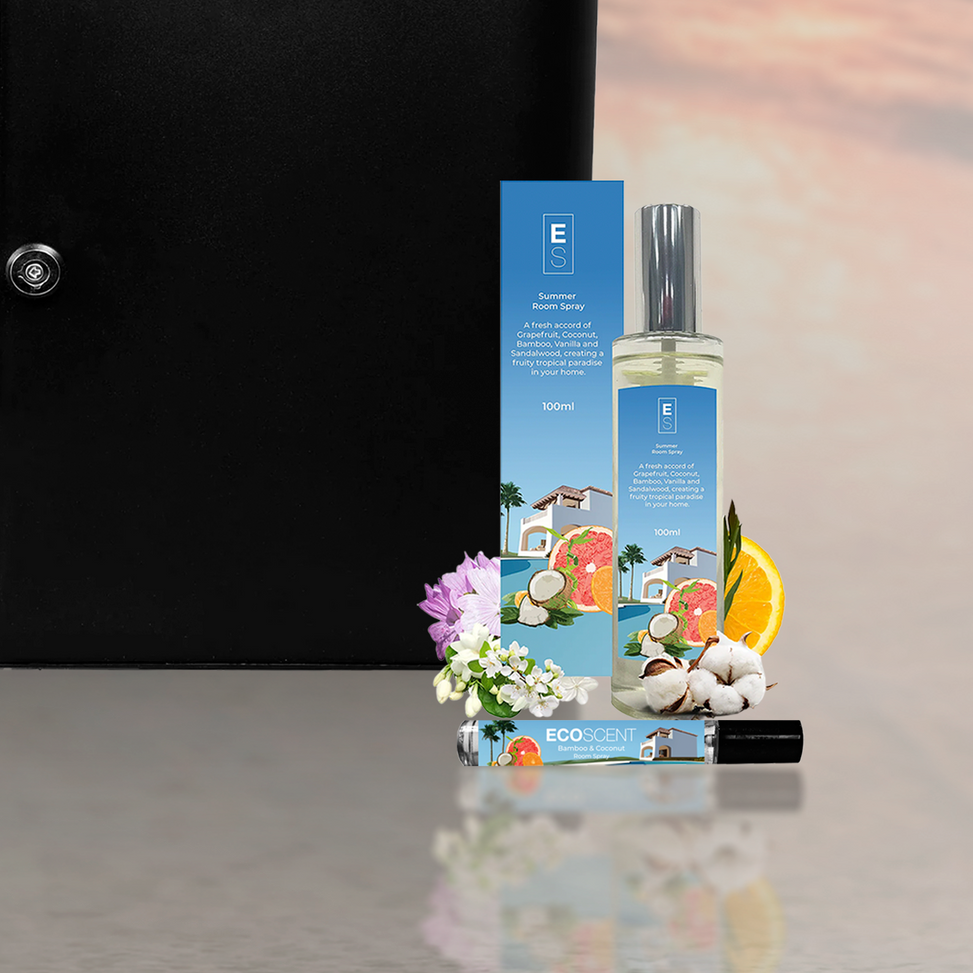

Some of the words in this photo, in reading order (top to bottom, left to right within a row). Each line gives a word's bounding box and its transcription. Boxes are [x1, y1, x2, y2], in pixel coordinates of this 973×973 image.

[550, 223, 567, 244] E
[550, 246, 567, 269] S
[538, 292, 577, 301] Summer
[532, 302, 559, 311] Room
[559, 302, 586, 312] Spray
[531, 321, 553, 329] fresh
[554, 321, 582, 329] accord
[582, 321, 592, 329] of
[516, 330, 561, 340] Grapefruit,
[561, 331, 599, 340] Coconut,
[516, 340, 553, 349] Bamboo,
[553, 340, 582, 348] Vanilla
[582, 340, 599, 348] and
[510, 349, 563, 358] Sandalwood,
[563, 349, 598, 359] creating
[512, 358, 535, 368] fruity
[535, 358, 567, 368] tropical
[567, 358, 603, 368] paradise
[530, 368, 540, 376] in
[540, 369, 559, 377] your
[560, 368, 587, 376] home.
[541, 401, 575, 412] 100ml
[662, 403, 673, 416] E
[632, 470, 669, 478] Grapefruit,
[632, 478, 663, 486] Bamboo,
[671, 486, 700, 494] creating
[629, 493, 649, 501] fruity
[648, 493, 675, 501] tropical
[674, 493, 704, 501] paradise
[653, 528, 681, 537] 100ml
[545, 727, 637, 743] ECOSCENT
[557, 744, 587, 752] Bamboo
[595, 744, 626, 752] Coconut
[573, 752, 592, 760] Room
[592, 752, 611, 761] Spray
